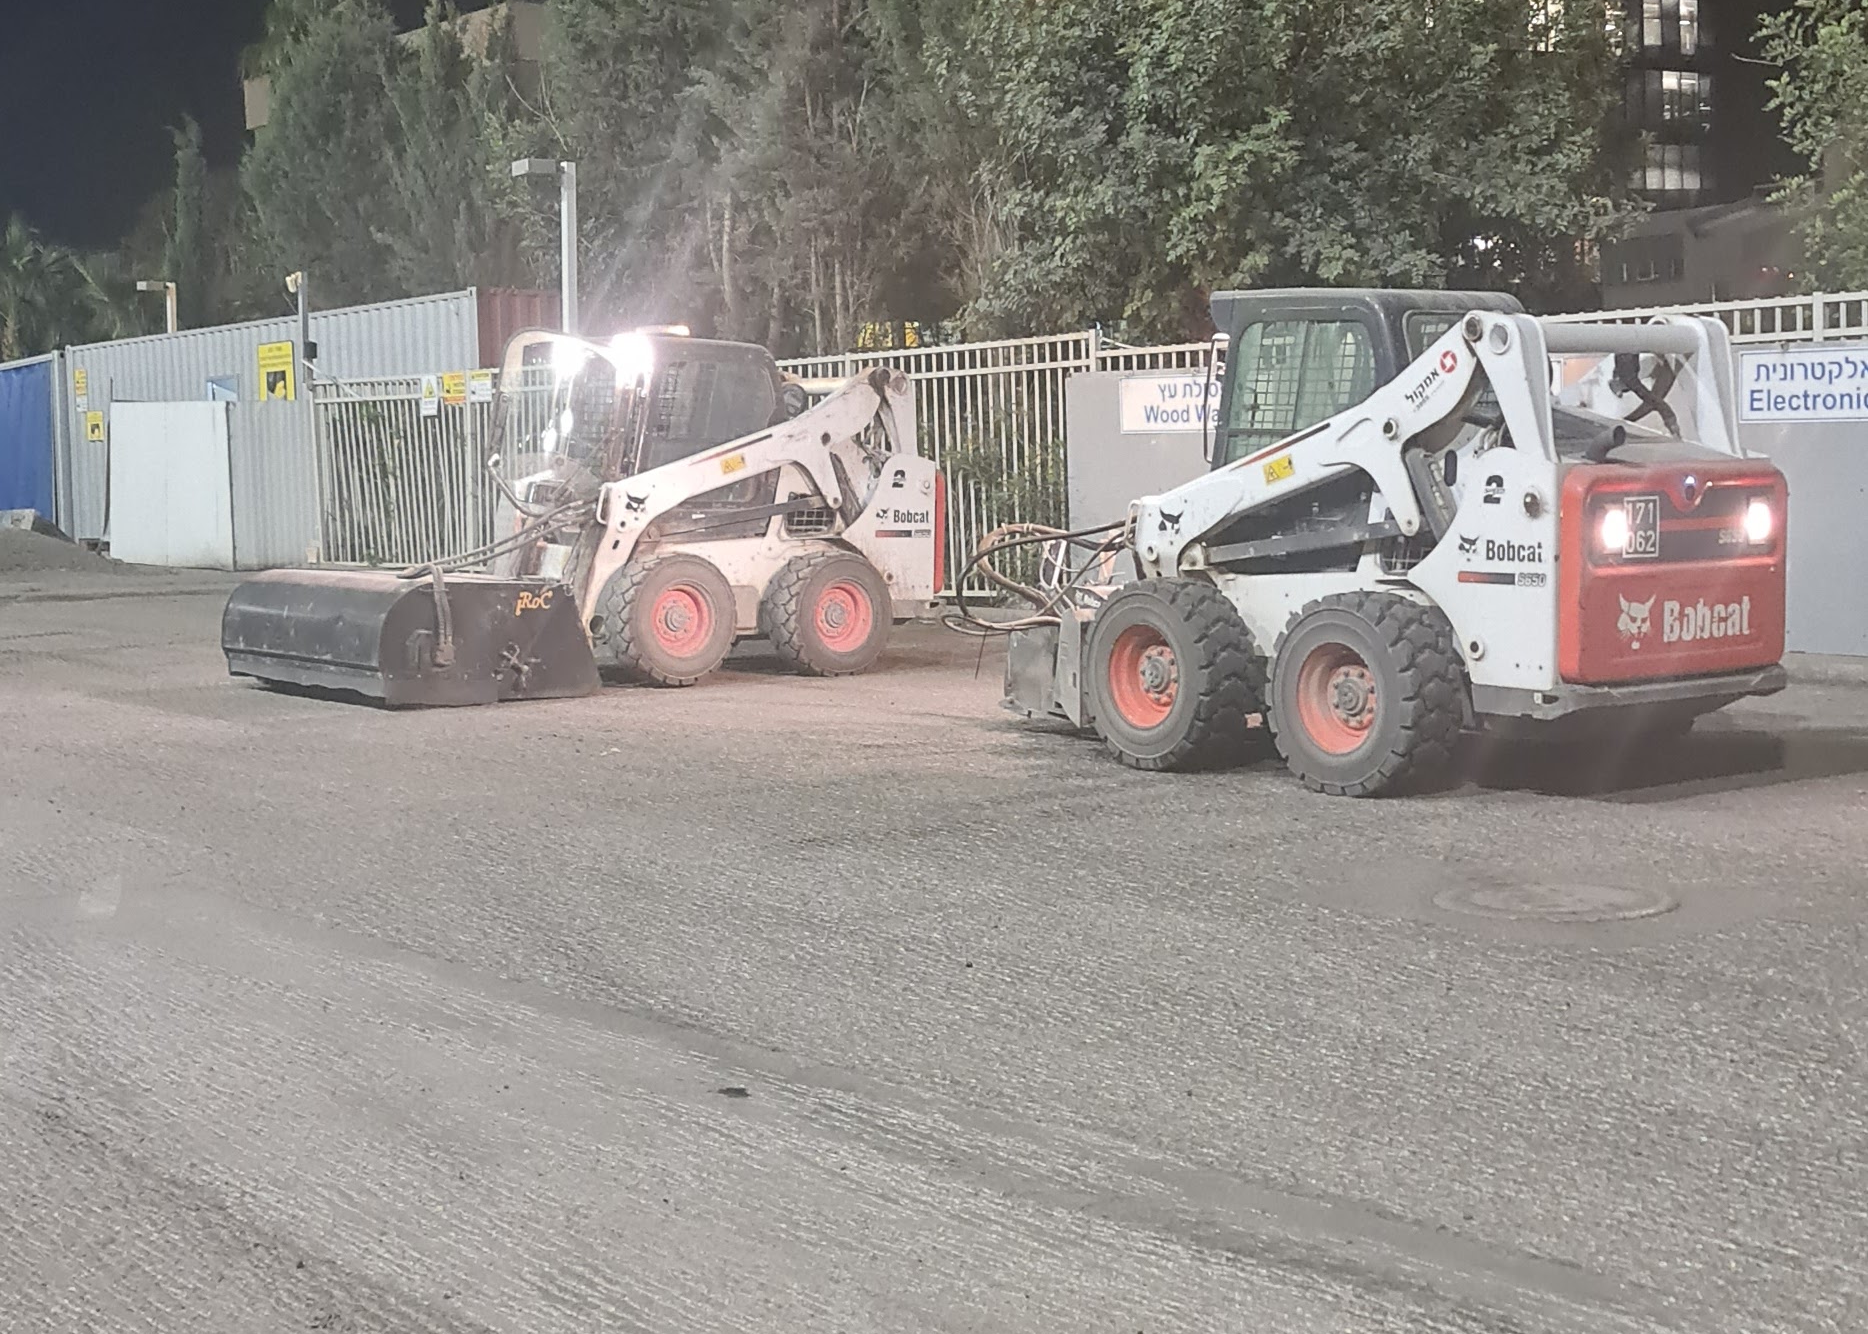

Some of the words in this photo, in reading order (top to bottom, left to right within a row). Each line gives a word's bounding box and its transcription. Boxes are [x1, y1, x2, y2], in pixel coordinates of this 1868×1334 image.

[1158, 383, 1177, 402] עץ
[1144, 404, 1190, 423] Wood
[893, 509, 929, 524] Bobcat
[1626, 502, 1654, 526] 171
[1486, 540, 1543, 563] Bobcat
[1626, 530, 1656, 553] 062
[1517, 572, 1547, 587] S650
[1663, 596, 1750, 643] Bobcat
